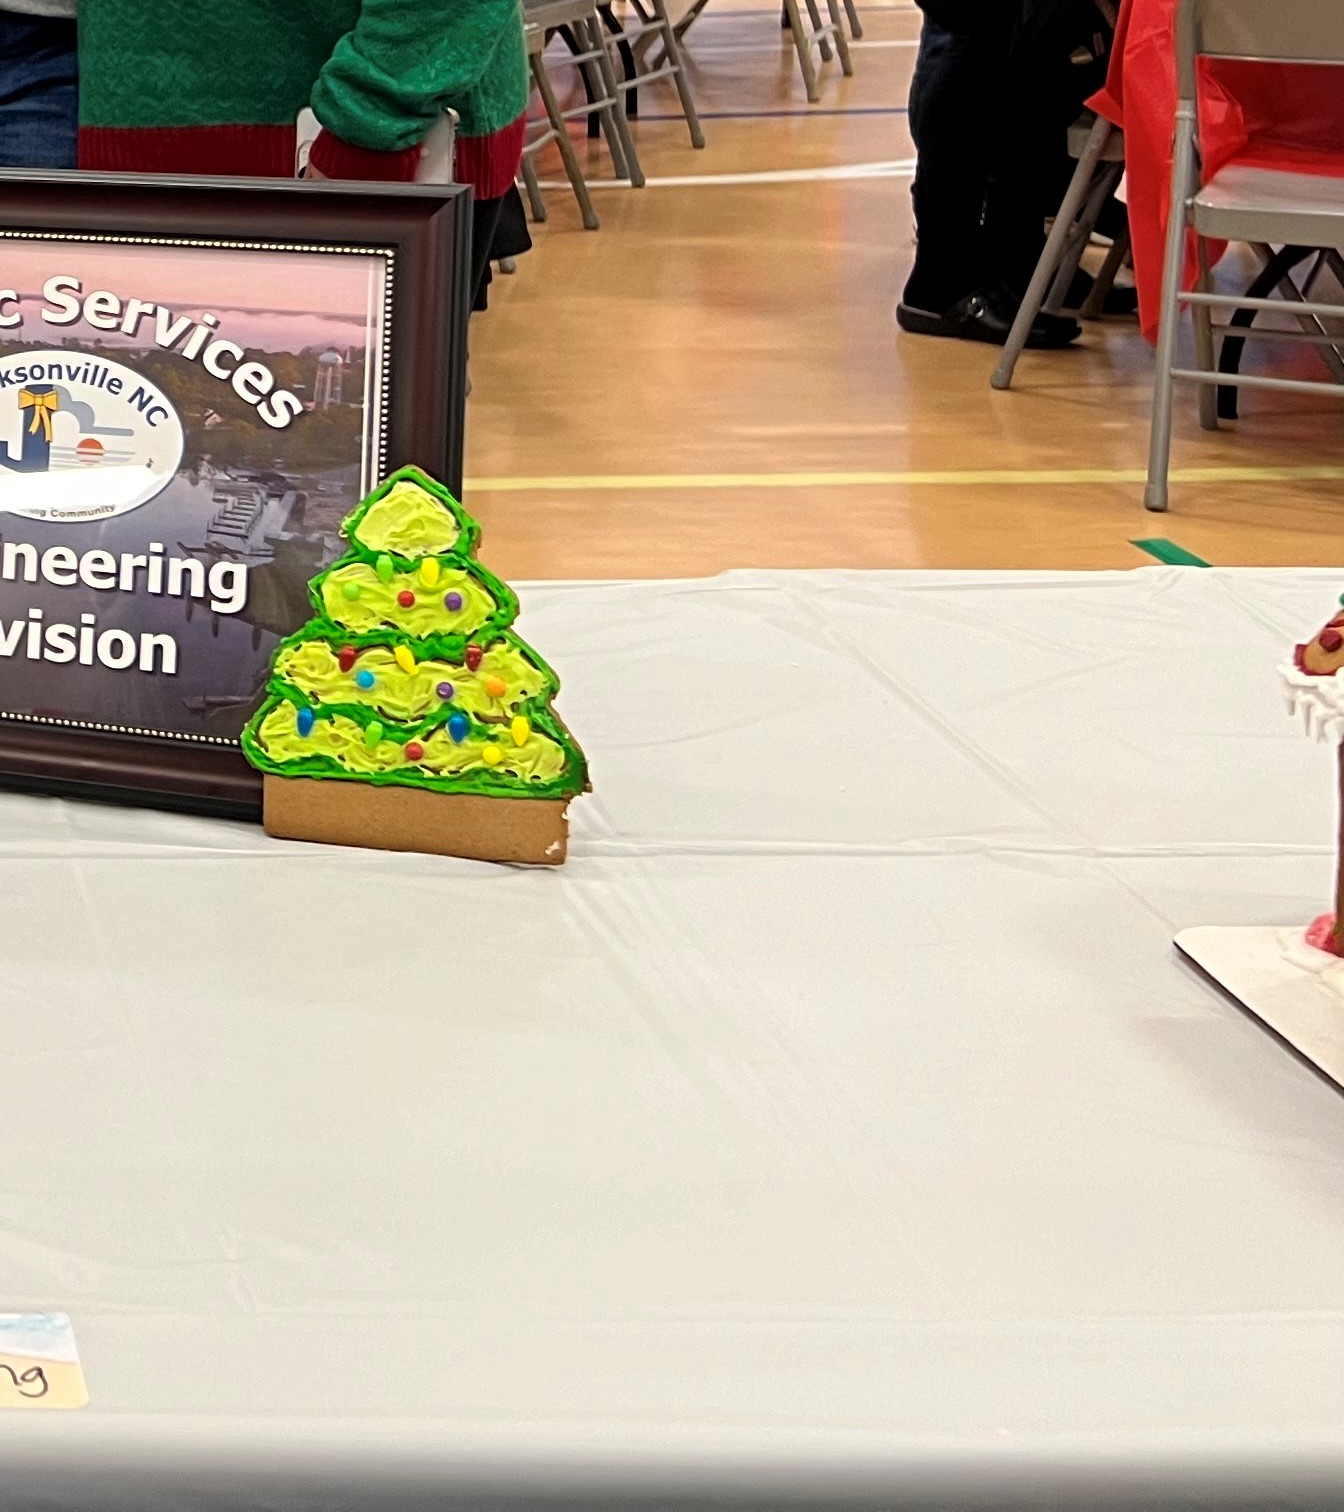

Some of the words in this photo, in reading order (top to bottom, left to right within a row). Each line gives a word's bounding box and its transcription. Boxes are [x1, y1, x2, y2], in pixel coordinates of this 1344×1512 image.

[41, 275, 302, 429] Services
[128, 387, 168, 427] NC
[50, 505, 115, 517] Community
